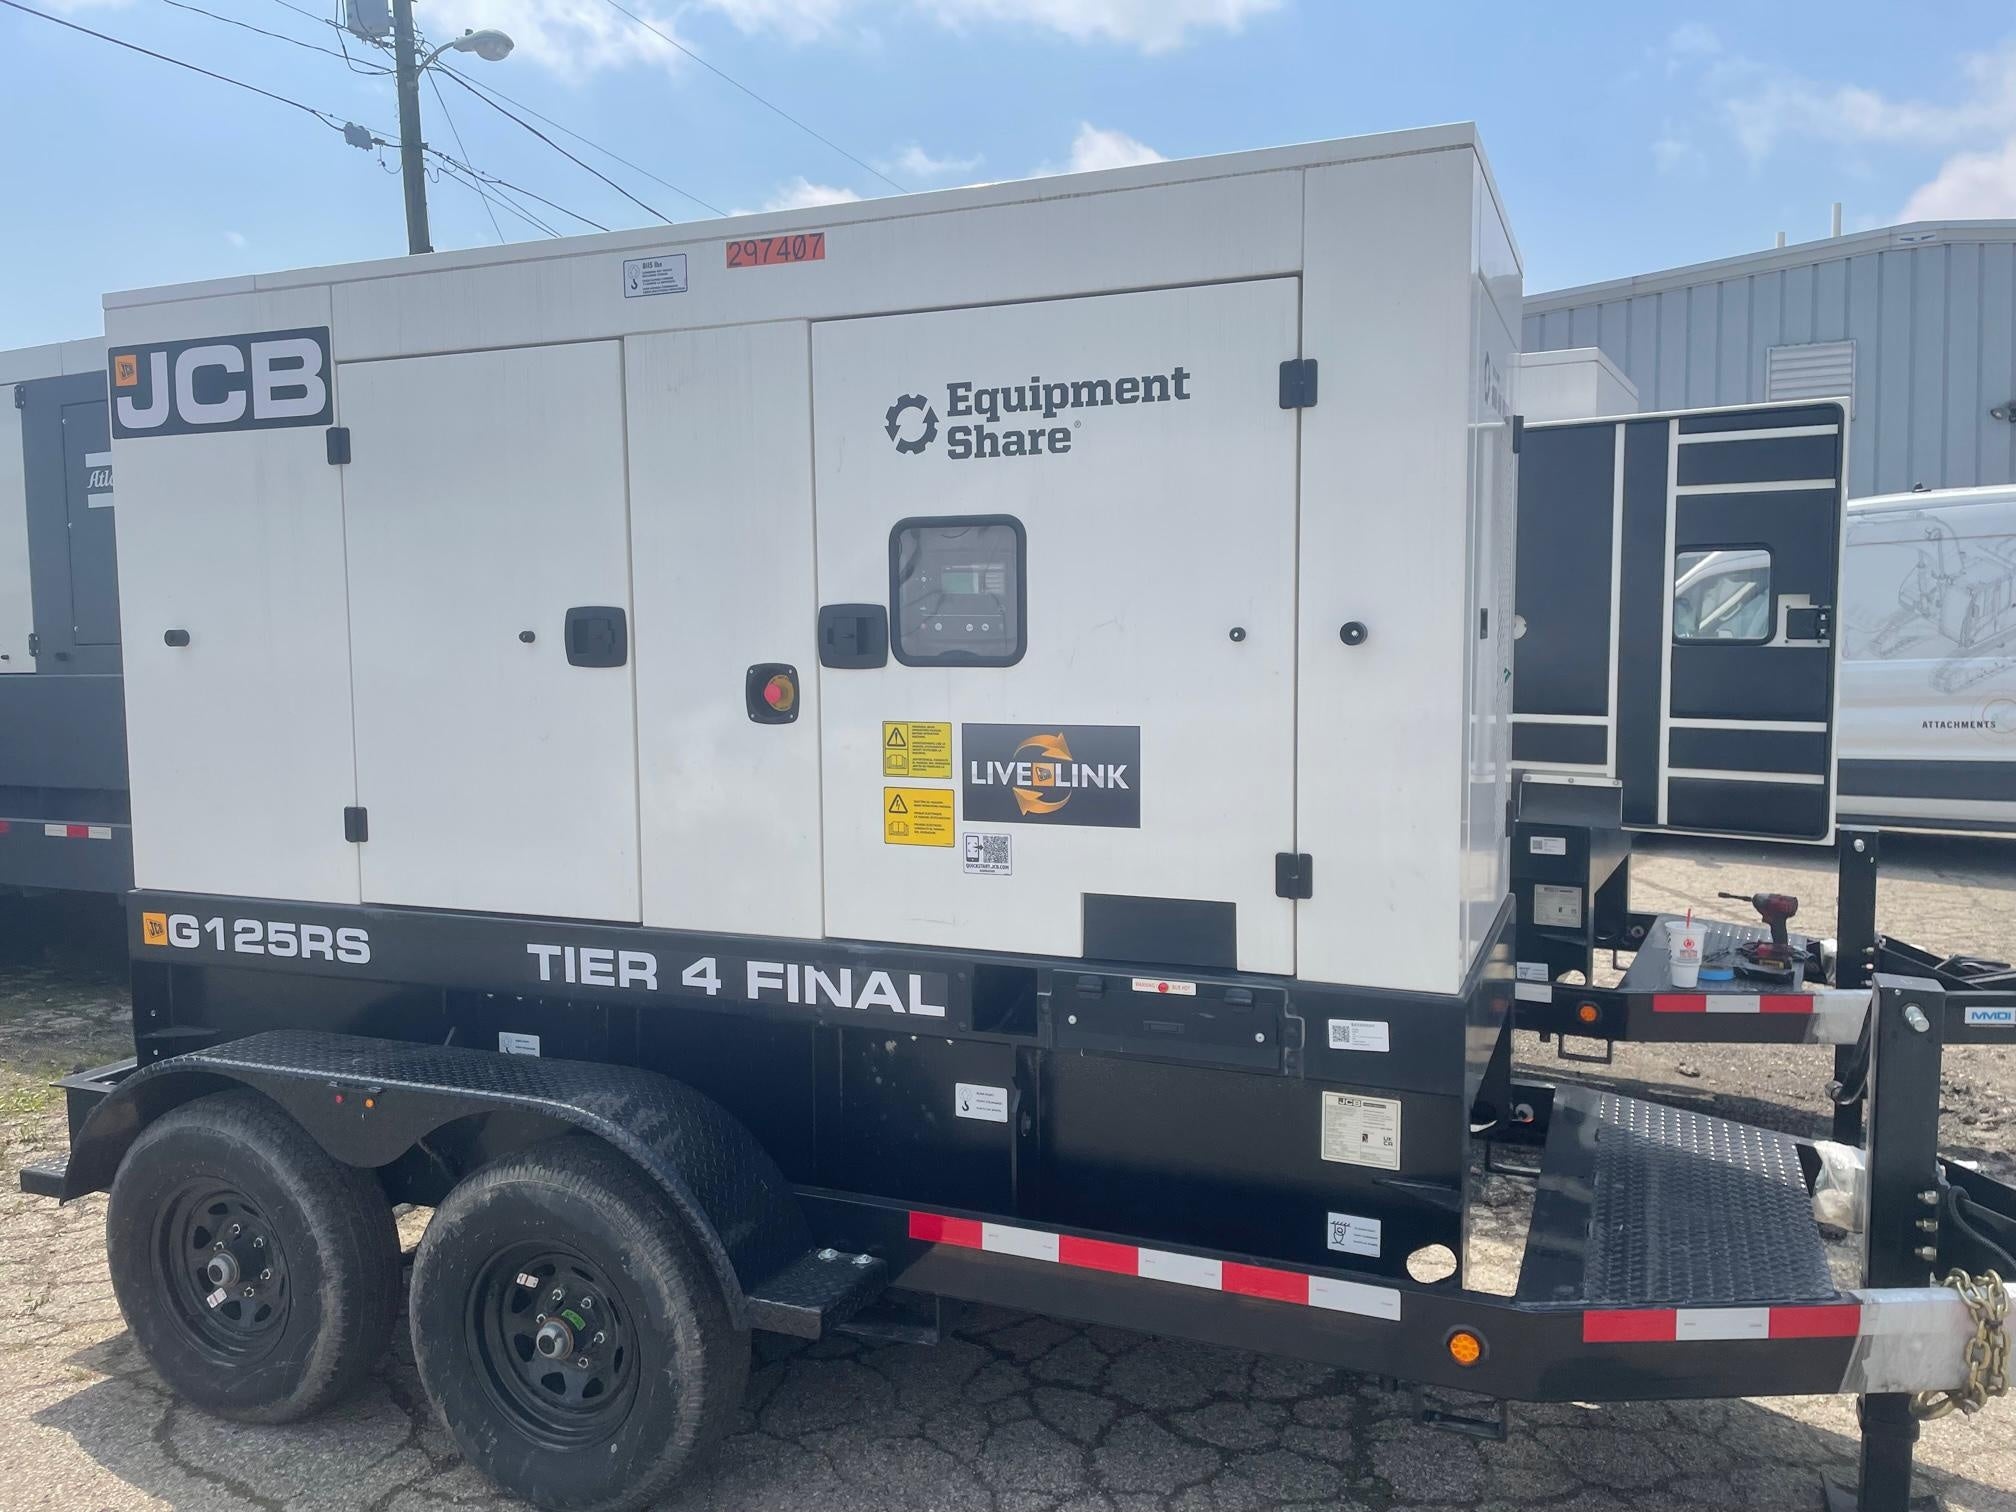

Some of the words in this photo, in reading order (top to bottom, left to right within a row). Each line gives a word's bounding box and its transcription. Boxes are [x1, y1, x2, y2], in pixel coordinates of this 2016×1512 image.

[728, 233, 824, 267] 297407
[116, 338, 327, 429] JCB
[946, 366, 1191, 423] Equipment
[947, 424, 1072, 460] Share
[1922, 720, 1997, 729] ATTACHMENTS
[971, 761, 1032, 786] LIVE
[1056, 763, 1130, 789] LINK
[167, 914, 371, 965] G125RS
[526, 943, 658, 991] TIER
[682, 957, 722, 996] 4
[746, 960, 946, 1017] FINAL
